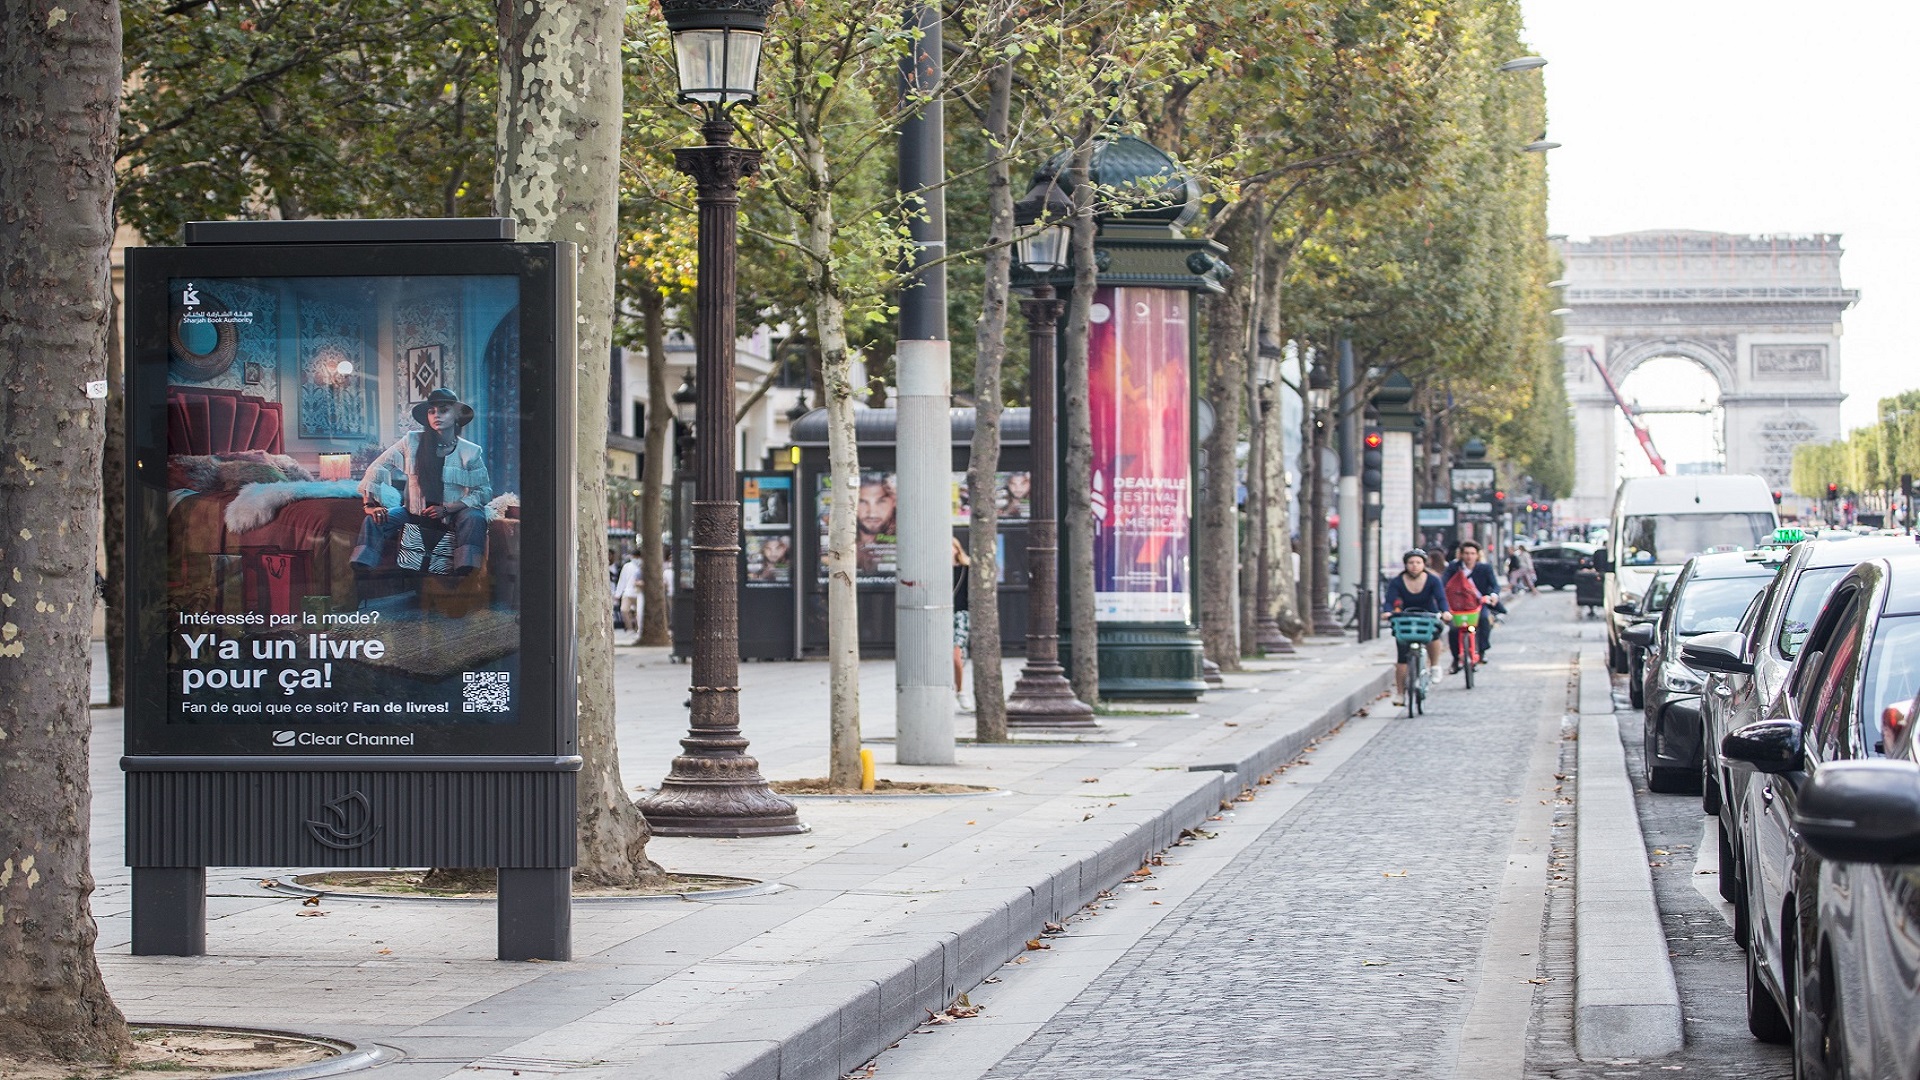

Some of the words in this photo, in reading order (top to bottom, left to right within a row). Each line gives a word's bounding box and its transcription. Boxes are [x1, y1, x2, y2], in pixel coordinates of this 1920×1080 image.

[183, 317, 207, 325] Sharjah
[223, 317, 253, 325] Authority
[1114, 477, 1186, 489] DEAUVILLE
[1114, 491, 1177, 503] FESTIVAL
[1777, 529, 1801, 540] TAXI
[179, 610, 265, 625] Intéressés
[269, 613, 298, 628] par
[302, 611, 317, 625] la
[322, 610, 380, 625] mode?
[181, 633, 240, 660] Y'a
[252, 639, 296, 660] un
[309, 633, 385, 660] livre
[182, 667, 268, 695] pour
[278, 662, 332, 696] ça!
[181, 702, 208, 714] Fan
[210, 702, 229, 714] de
[232, 702, 262, 716] quoi
[265, 704, 292, 716] que
[295, 704, 312, 714] ce
[315, 702, 350, 714] soit?
[353, 702, 380, 714] Fan
[383, 702, 403, 714] de
[406, 702, 450, 714] livres!
[298, 732, 343, 746] Clear
[345, 732, 415, 746] Channel
